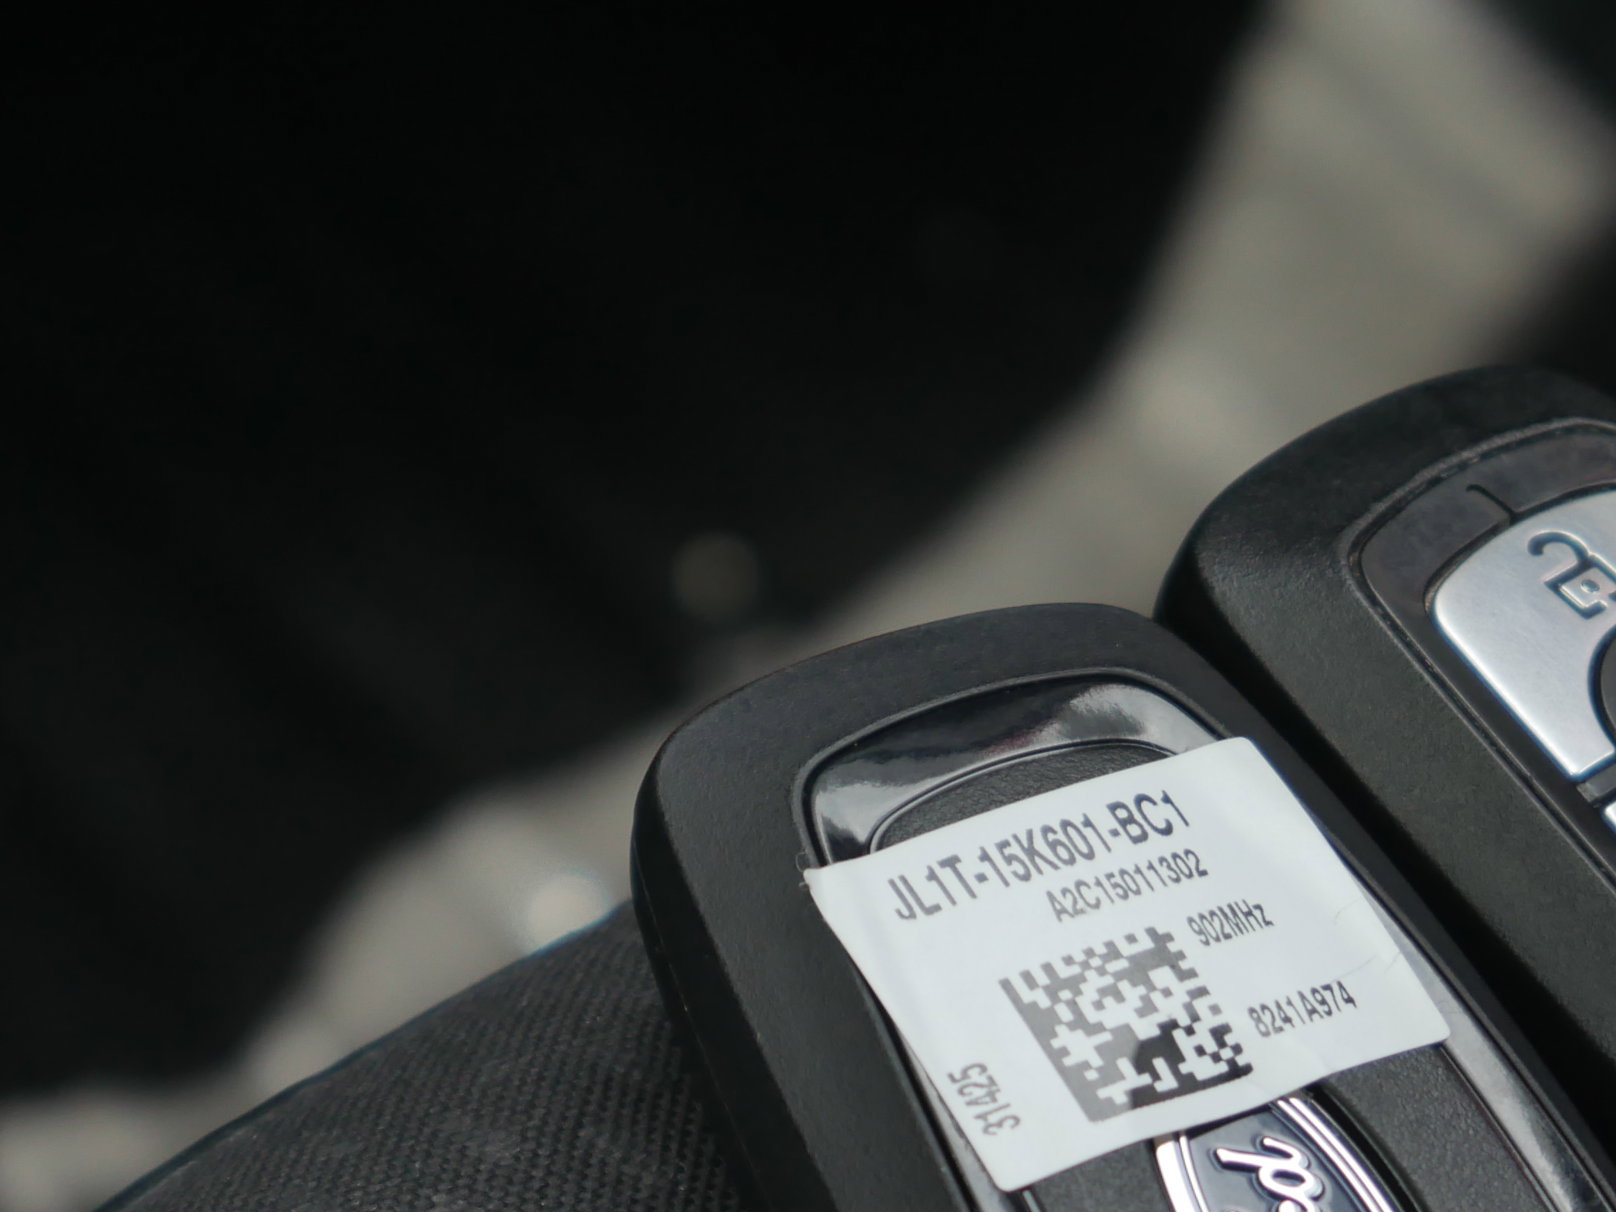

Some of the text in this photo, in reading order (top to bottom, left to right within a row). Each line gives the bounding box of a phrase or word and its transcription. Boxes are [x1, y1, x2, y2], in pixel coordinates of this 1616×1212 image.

[887, 790, 1190, 920] JL1T-15K601-BC1
[1046, 849, 1208, 922] A2C15011302
[1186, 899, 1274, 946] 902MHz
[1247, 980, 1358, 1038] 8241A974
[946, 1062, 1021, 1136] 31425
